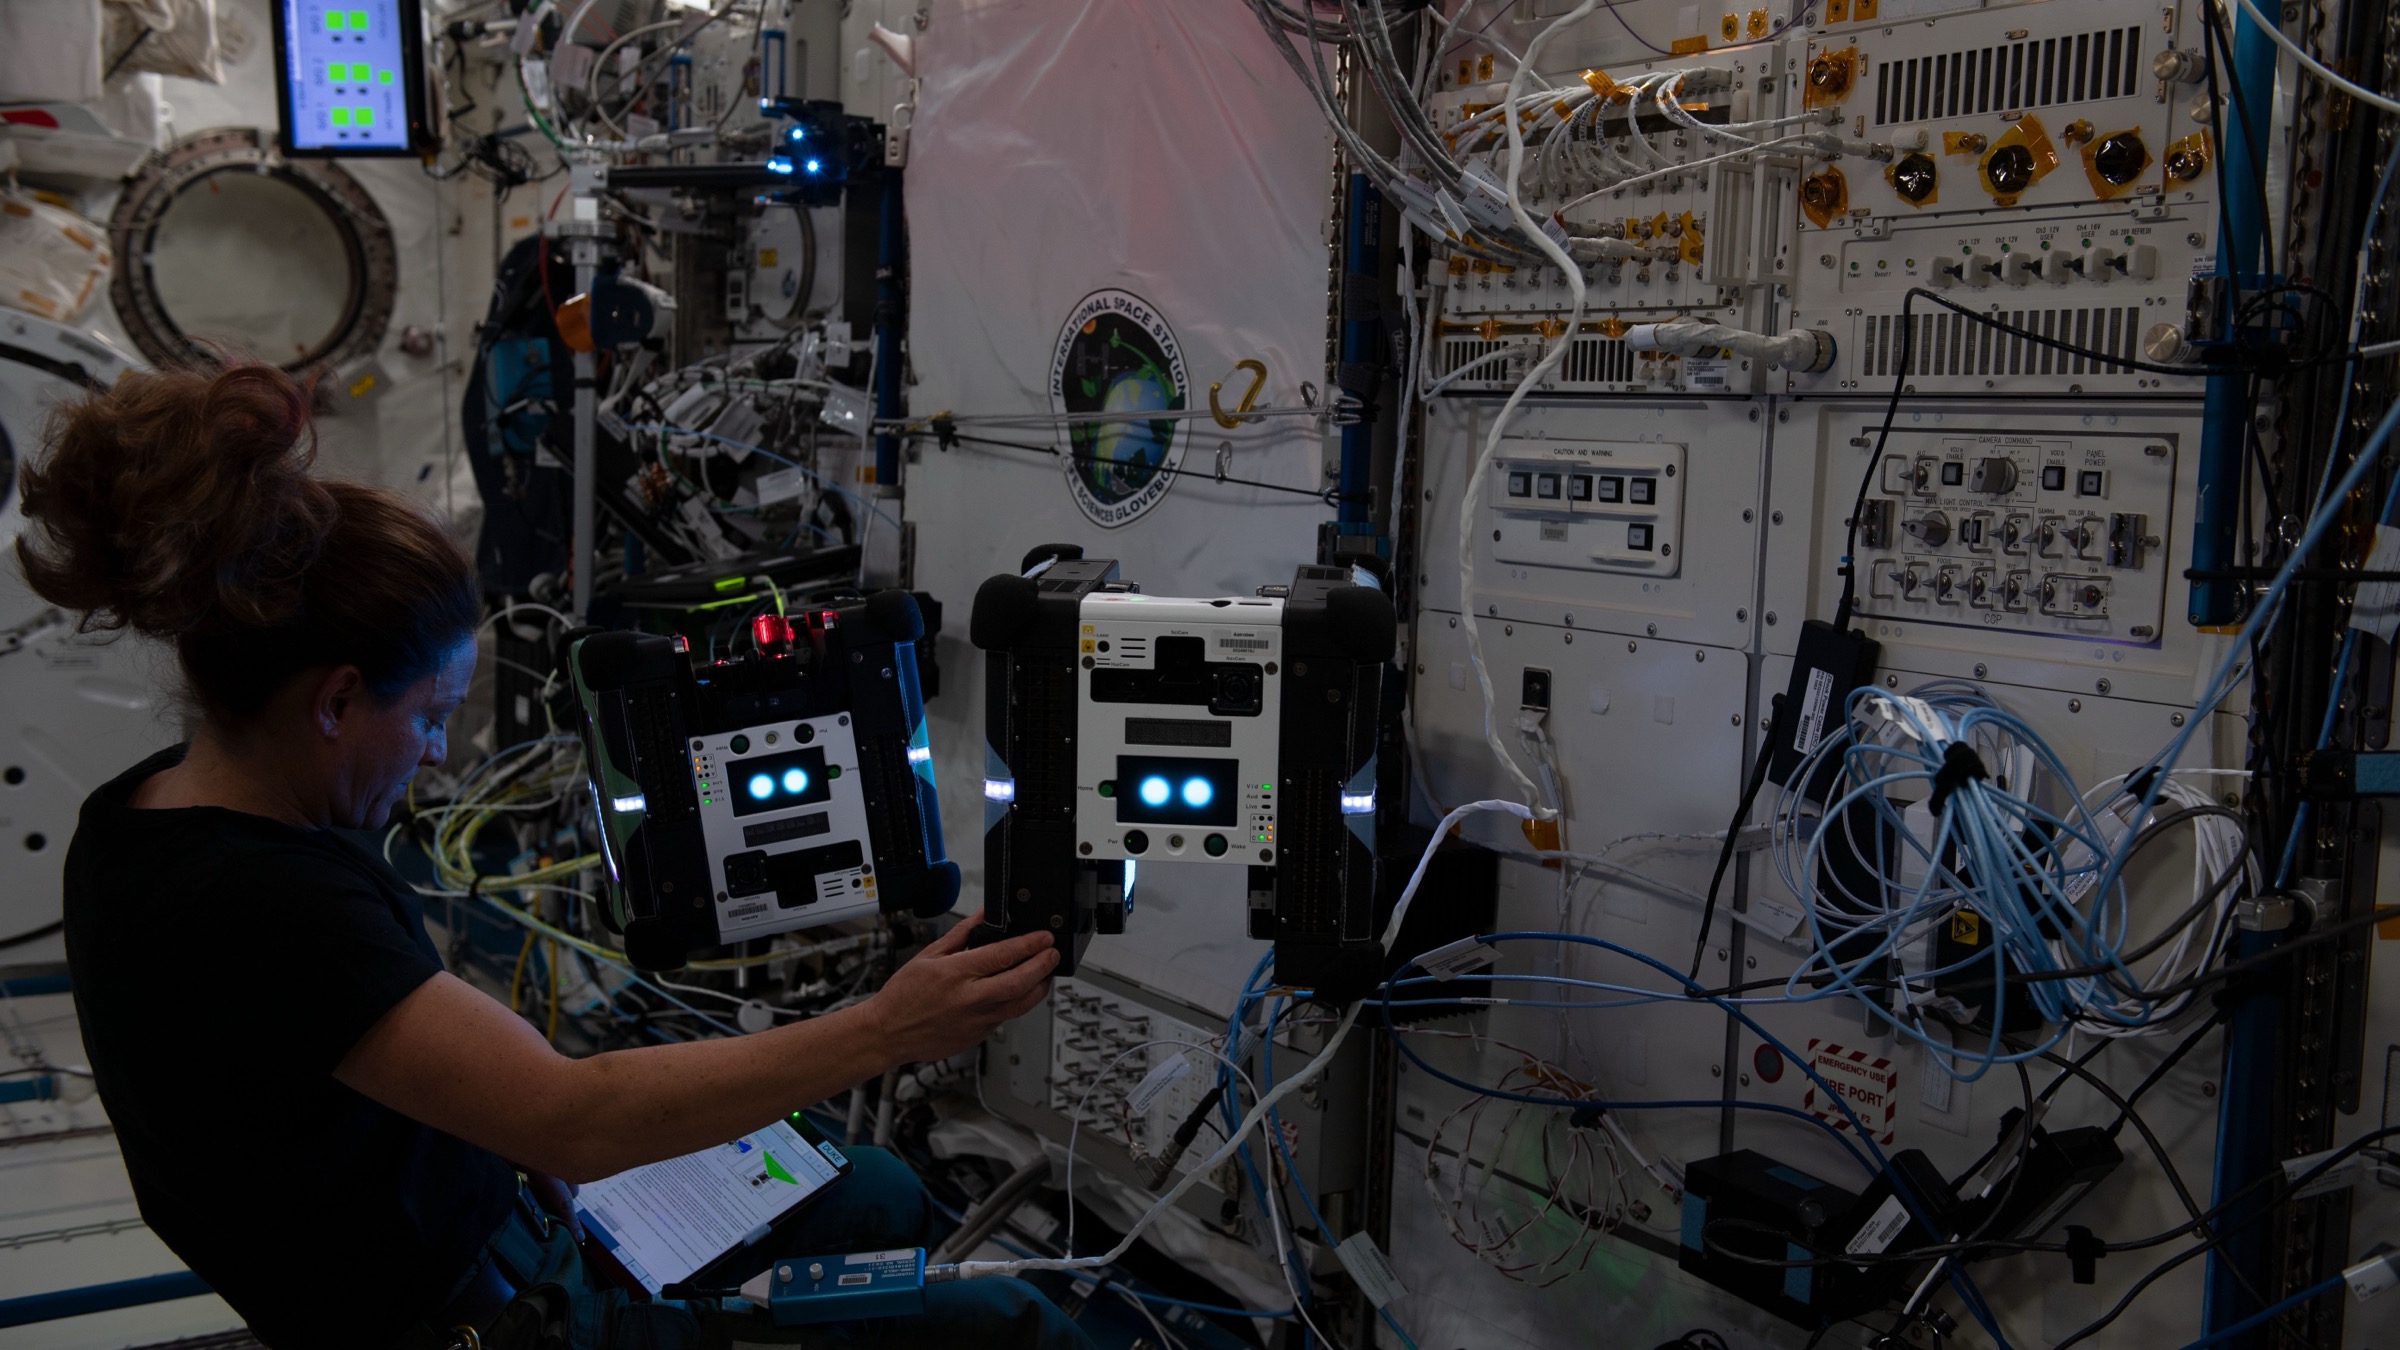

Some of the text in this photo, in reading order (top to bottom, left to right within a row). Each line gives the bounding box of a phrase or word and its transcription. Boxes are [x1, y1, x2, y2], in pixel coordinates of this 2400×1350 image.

[2036, 226, 2060, 234] Ch3 12V
[1970, 238, 1980, 246] 12V
[1053, 296, 1187, 397] INTERNATIONAL SPACE STATION
[1978, 436, 2002, 444] CAMERA
[1554, 448, 1574, 456] CAUTION
[2086, 450, 2106, 458] PANEL
[2046, 458, 2065, 466] ENABLE
[2084, 458, 2106, 467] POWER
[1077, 485, 1115, 523] SCIENCES
[1115, 457, 1177, 522] GLOVEBOX
[1940, 498, 1957, 506] LIGHT
[1960, 500, 1984, 508] CONTROL
[2088, 566, 2098, 574] PAN
[1820, 696, 1829, 714] Power
[1815, 715, 1825, 734] Cable
[1818, 1055, 1886, 1083] EMERGENCY USE
[1849, 1086, 1884, 1108] PORT
[1861, 1114, 1871, 1124] F2
[822, 1144, 842, 1163] DUKE
